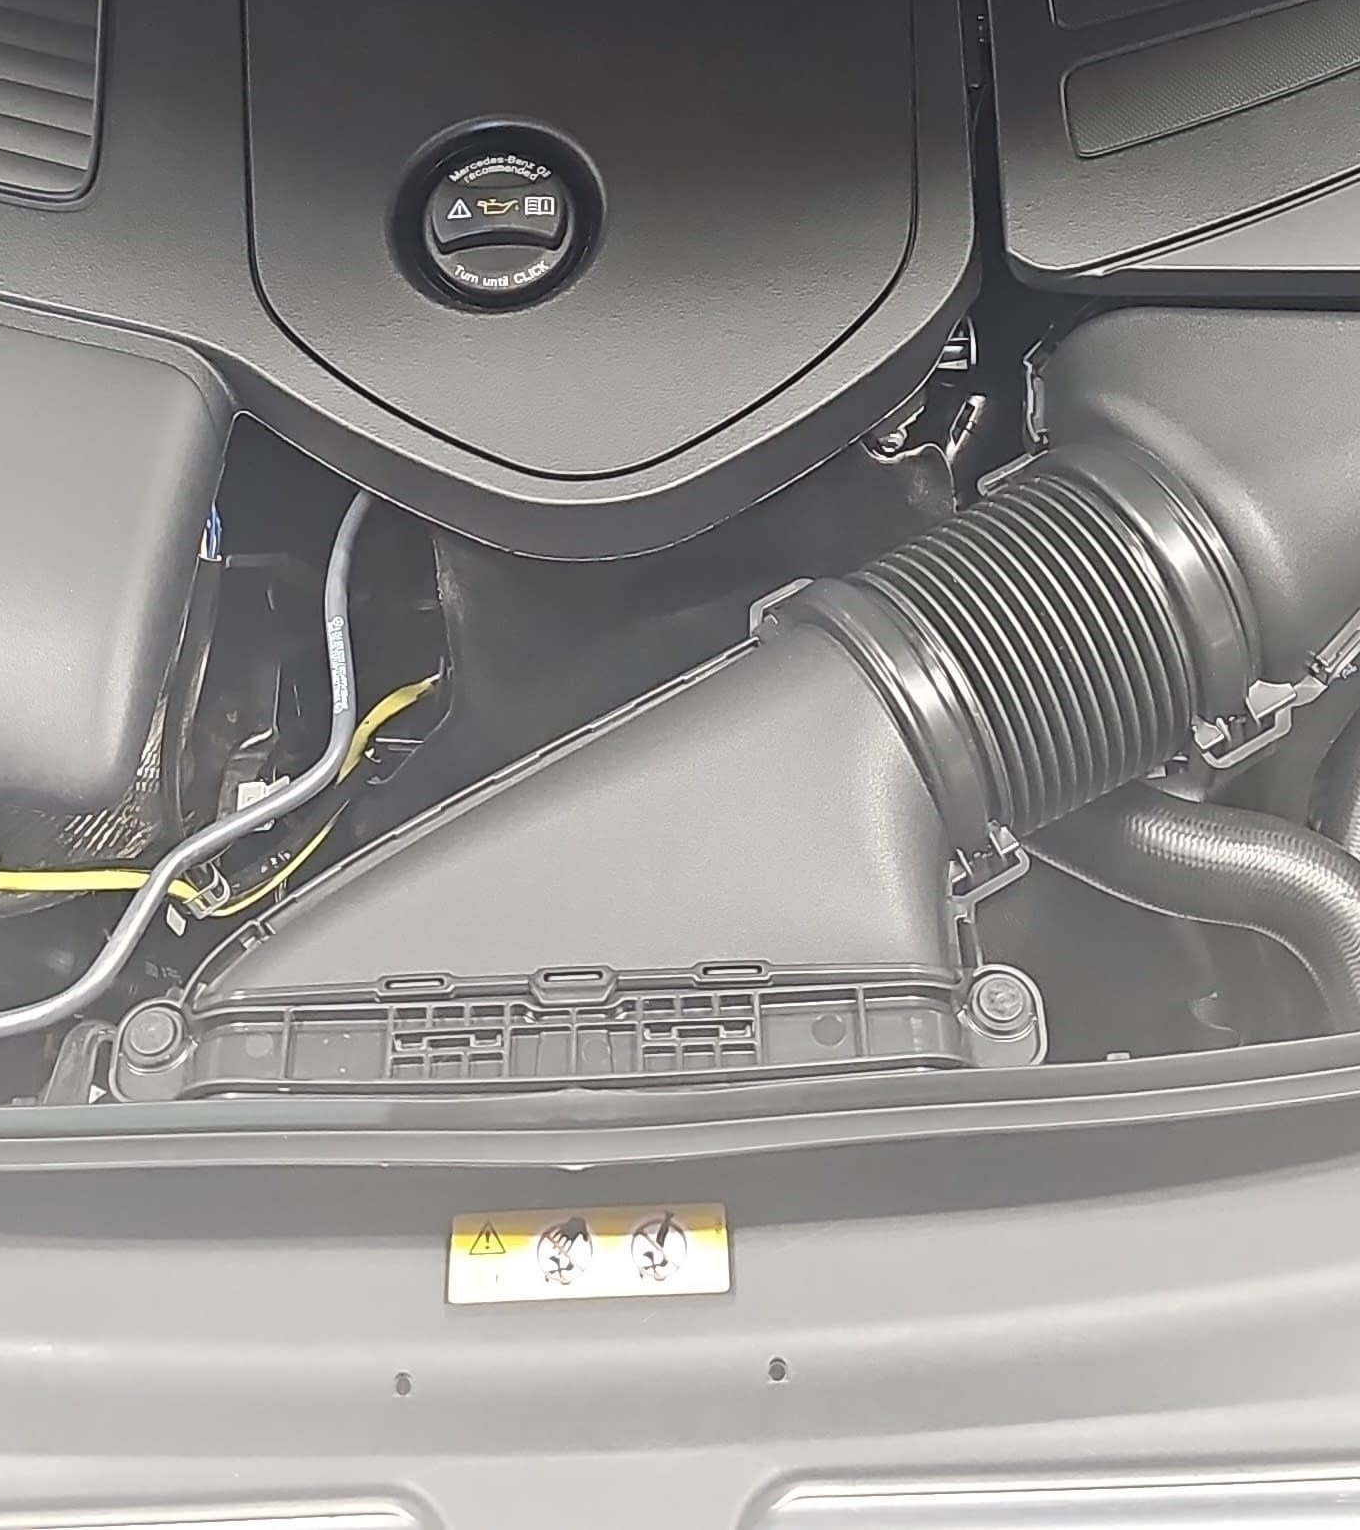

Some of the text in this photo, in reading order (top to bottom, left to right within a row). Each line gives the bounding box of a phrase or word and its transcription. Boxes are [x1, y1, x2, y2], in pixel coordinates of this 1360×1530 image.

[448, 155, 535, 183] Mercedes-Benz
[464, 164, 538, 184] recommended
[453, 260, 551, 287] Turn until CLICK
